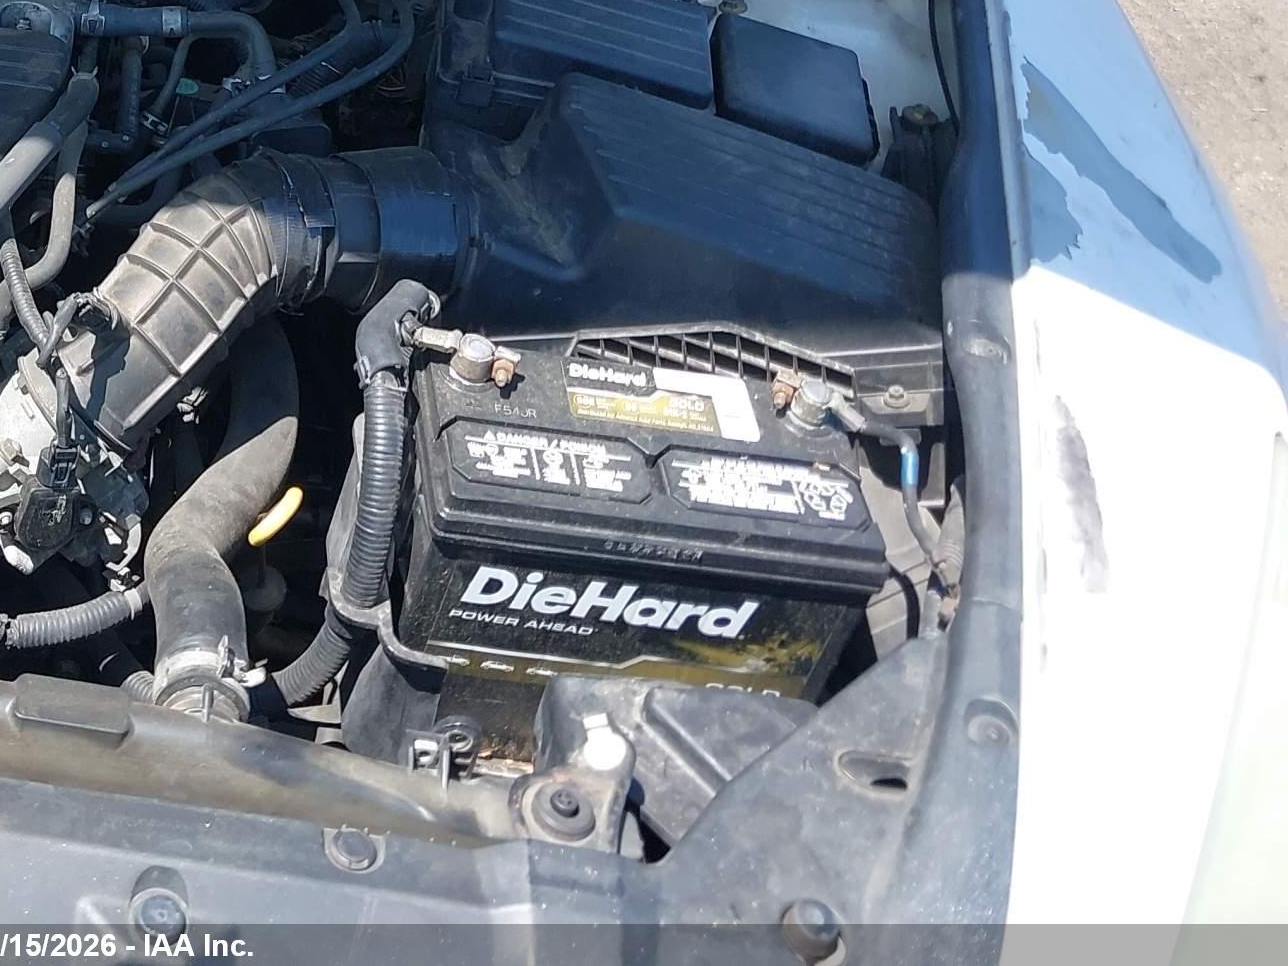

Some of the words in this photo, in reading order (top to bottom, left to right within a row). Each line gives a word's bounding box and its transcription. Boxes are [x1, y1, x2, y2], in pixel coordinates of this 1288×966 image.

[568, 362, 647, 387] DieHard
[461, 565, 760, 639] DieHard
[449, 608, 519, 627] POWER
[524, 618, 595, 635] AHEAD
